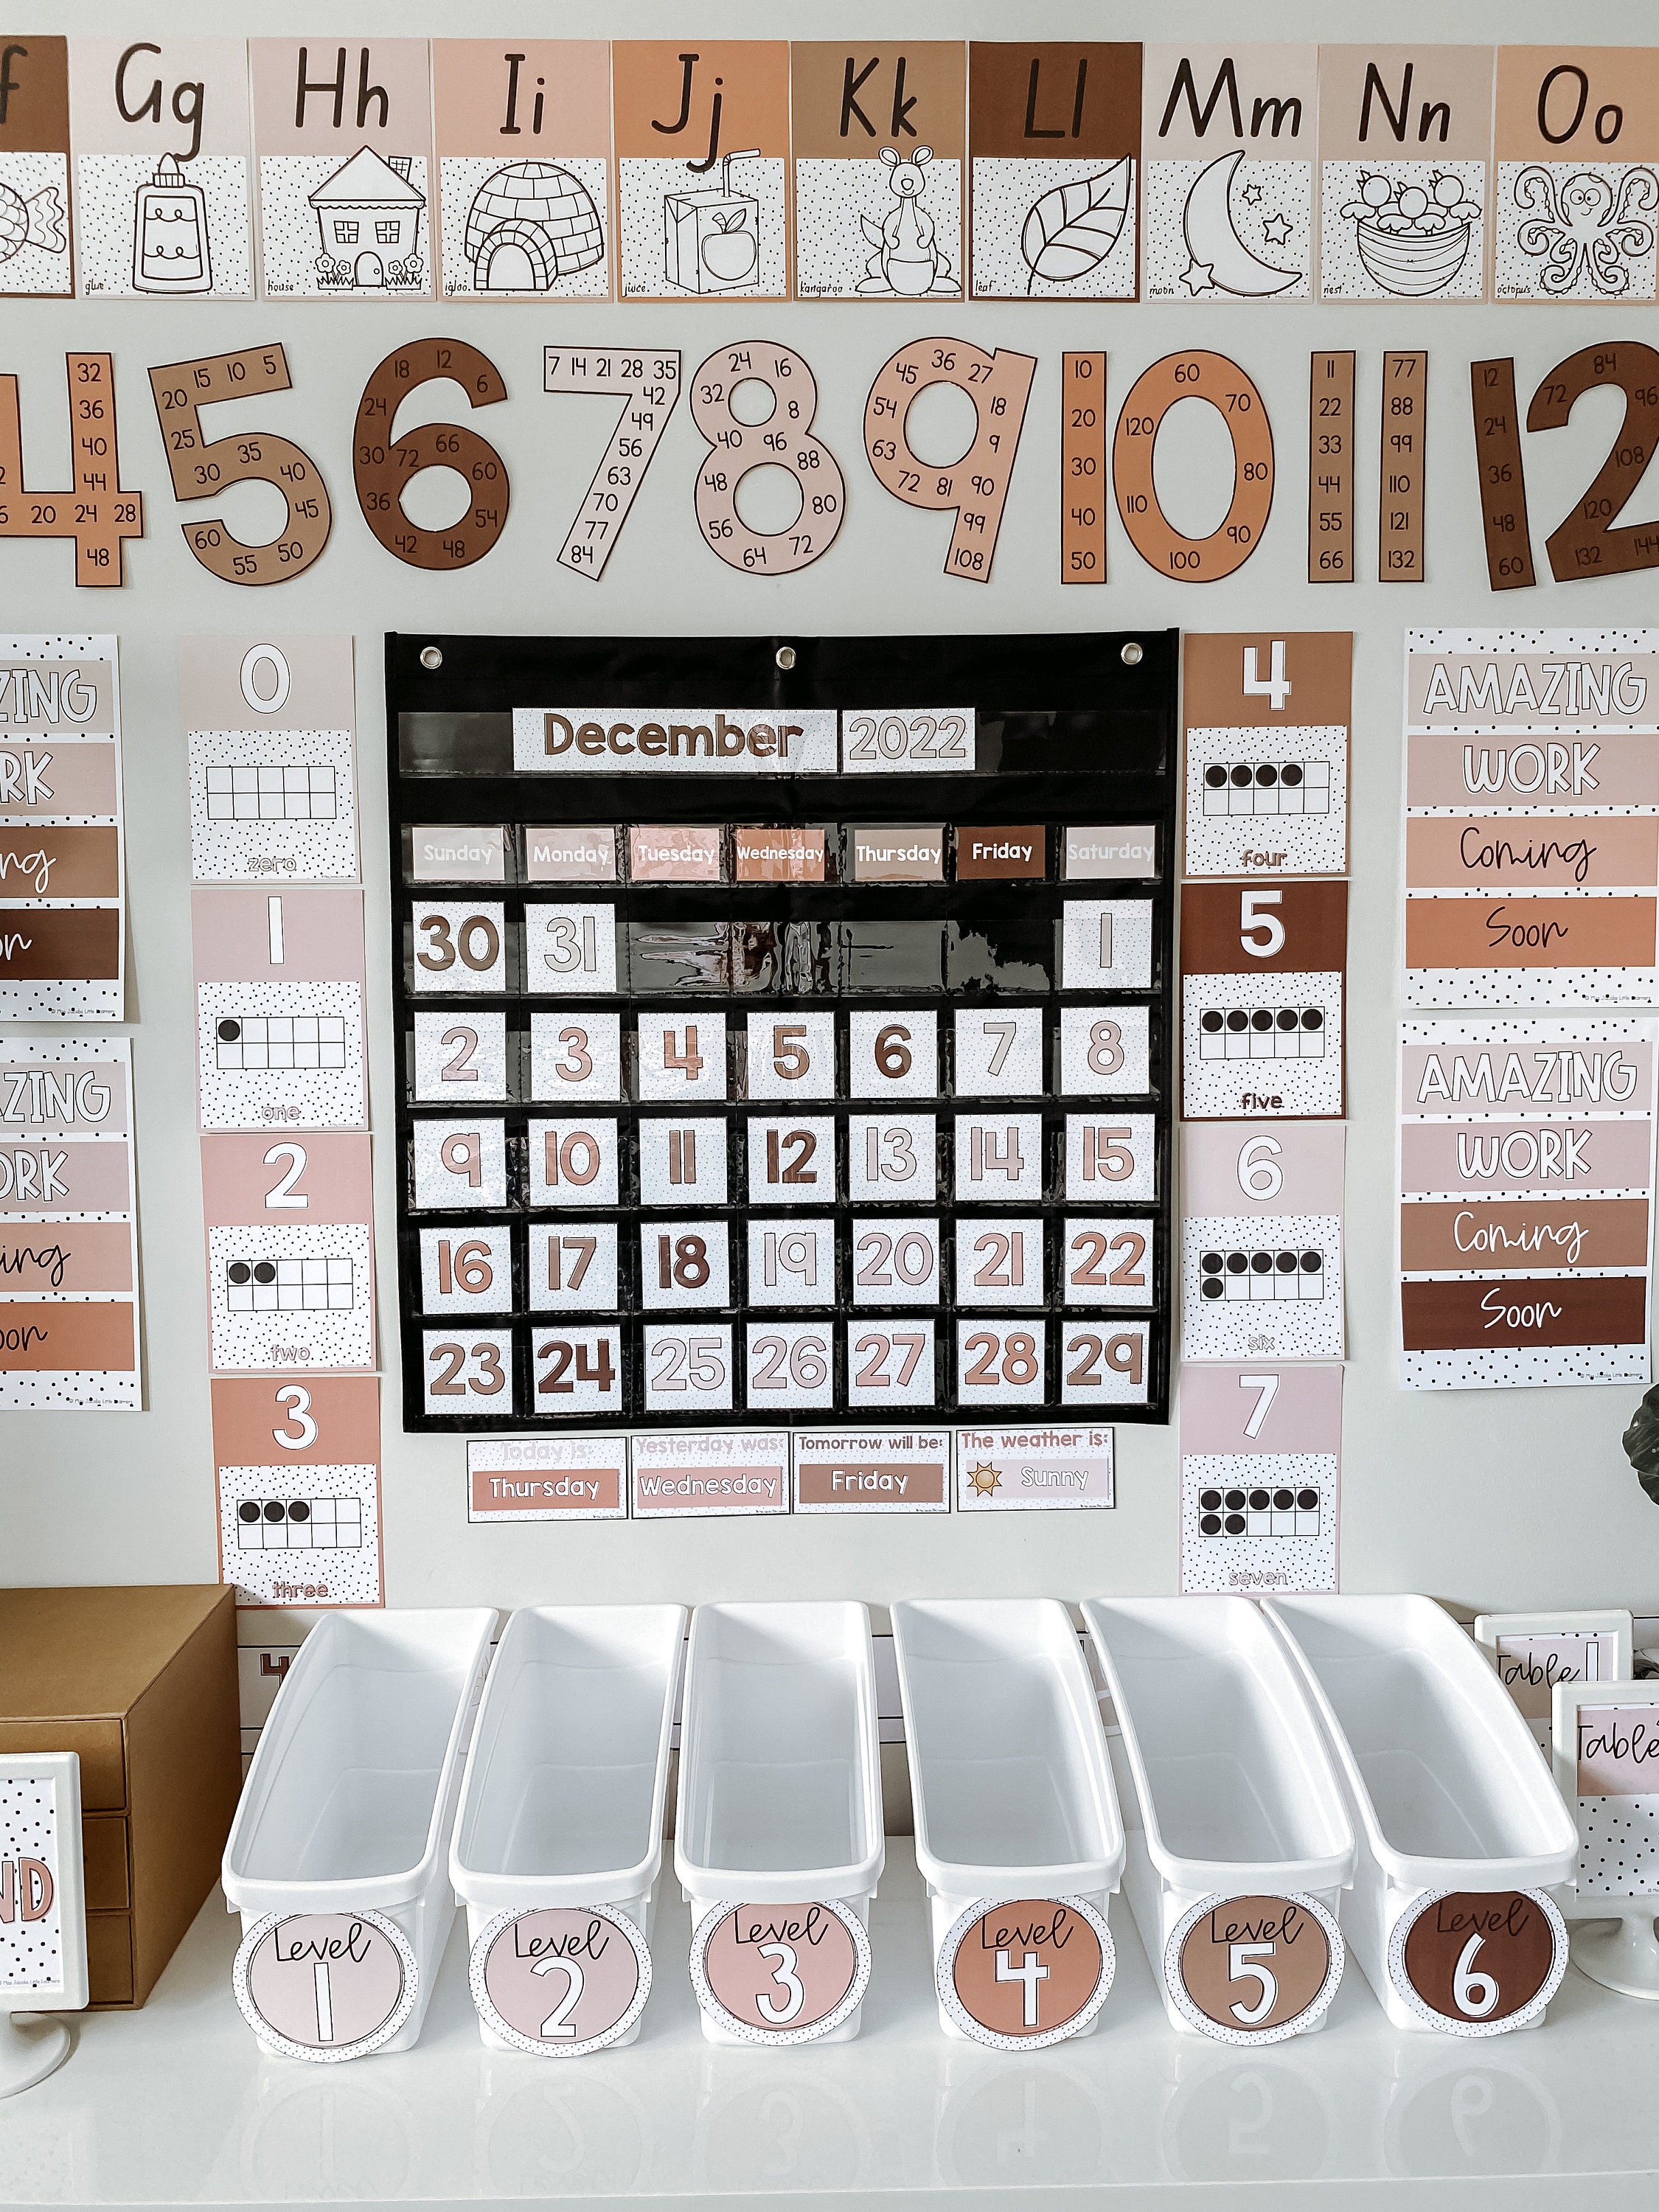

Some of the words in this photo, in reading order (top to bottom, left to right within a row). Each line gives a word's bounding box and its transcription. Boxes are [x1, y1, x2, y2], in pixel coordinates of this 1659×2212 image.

[294, 46, 390, 129] Hh
[499, 52, 546, 136] Ii
[838, 56, 919, 138] Kk
[1023, 58, 1088, 139] Ll
[1158, 57, 1301, 139] Mm
[114, 41, 205, 161] Gg
[650, 53, 724, 173] Jj
[1357, 61, 1453, 142] Nn
[1537, 64, 1624, 145] Oo
[85, 280, 105, 295] glue
[267, 279, 295, 291] house
[799, 282, 844, 297] kangaroo
[975, 280, 995, 293] leaf
[1148, 286, 1175, 294] moon
[1323, 285, 1343, 294] nest
[1497, 285, 1531, 297] octopus
[192, 368, 212, 389] 15
[226, 362, 246, 383] 10
[263, 354, 278, 375] 5
[548, 356, 560, 378] 7
[570, 357, 587, 378] 14
[595, 358, 612, 378] 21
[620, 358, 644, 379] 28
[653, 360, 678, 380] 35
[728, 351, 752, 372] 24
[931, 349, 957, 372] 36
[1326, 359, 1336, 380] 11
[1593, 352, 1618, 375] 84
[1174, 364, 1201, 384] 60
[1483, 368, 1499, 388] 12
[79, 399, 105, 420] 36
[364, 397, 388, 417] 24
[787, 400, 801, 420] 8
[1125, 417, 1155, 437] 120
[81, 437, 108, 457] 40
[353, 337, 511, 571] 6
[434, 434, 461, 454] 66
[762, 432, 788, 453] 96
[1318, 434, 1343, 455] 33
[147, 342, 332, 586] 5
[543, 345, 682, 582] 7
[689, 340, 846, 575] 8
[863, 336, 1037, 583] 9
[1061, 349, 1275, 585] 10
[1071, 456, 1097, 477] 30
[1307, 350, 1428, 584] 11
[1487, 463, 1513, 484] 36
[935, 477, 954, 498] 81
[30, 505, 58, 525] 20
[113, 504, 137, 524] 28
[294, 498, 320, 519] 45
[963, 512, 987, 535] 99
[1389, 512, 1410, 531] 121
[393, 535, 418, 554] 42
[570, 546, 594, 566] 84
[742, 546, 768, 568] 64
[953, 548, 985, 571] 108
[1169, 551, 1201, 571] 100
[1387, 549, 1416, 569] 132
[239, 643, 291, 714] 0
[1242, 639, 1292, 711] 4
[1423, 661, 1648, 716] AMAZING
[544, 713, 805, 758] December
[849, 714, 967, 760] 2022
[1463, 742, 1601, 796] WORK
[247, 857, 298, 873] zero
[423, 844, 493, 865] Sunday
[533, 844, 610, 864] Monday
[638, 844, 714, 865] Tuesday
[737, 846, 825, 863] Wednesday
[855, 844, 942, 865] Thursday
[971, 842, 1033, 861] Friday
[1068, 842, 1155, 862] Saturday
[1241, 849, 1288, 867] four
[1460, 827, 1597, 883] Coming
[1239, 889, 1286, 959] 5
[1485, 905, 1569, 949] Soon
[417, 914, 500, 972] 30
[543, 916, 597, 973] 31
[441, 1026, 479, 1082] 2
[554, 1026, 593, 1082] 3
[663, 1025, 703, 1080] 4
[773, 1025, 810, 1080] 5
[874, 1023, 912, 1079] 6
[983, 1021, 1017, 1077] 7
[1087, 1020, 1124, 1075] 8
[1416, 1050, 1638, 1104] AMAZING
[261, 1105, 302, 1121] one
[1240, 1092, 1283, 1110] five
[1456, 1129, 1593, 1180] WORK
[262, 1141, 310, 1209] 2
[1237, 1134, 1284, 1202] 6
[1453, 1211, 1590, 1265] Coming
[1480, 1287, 1562, 1329] Soon
[270, 1343, 311, 1362] two
[1248, 1334, 1276, 1352] six
[429, 1342, 506, 1396] 23
[537, 1338, 616, 1393] 24
[651, 1337, 726, 1391] 25
[752, 1335, 827, 1389] 26
[855, 1333, 926, 1387] 27
[964, 1332, 1039, 1385] 28
[1067, 1332, 1144, 1385] 29
[271, 1383, 319, 1451] 3
[1239, 1373, 1280, 1440] 7
[635, 1436, 734, 1455] Yesterday
[799, 1436, 883, 1450] Tomorrow
[888, 1435, 914, 1450] will
[917, 1435, 944, 1450] be:
[961, 1432, 994, 1449] The
[1000, 1430, 1082, 1449] weather
[1088, 1430, 1109, 1447] is:
[500, 1442, 564, 1463] Today
[489, 1475, 601, 1500] Thursday
[639, 1473, 778, 1498] Wednesday
[831, 1470, 909, 1495] Friday
[1020, 1466, 1089, 1491] Sunny
[271, 1581, 329, 1599] three
[1228, 1571, 1288, 1586] seven
[1497, 1652, 1581, 1689] Table
[733, 1906, 830, 1947] Level
[980, 1907, 1074, 1950] Level
[1209, 1905, 1307, 1947] Level
[1436, 1897, 1530, 1937] Level
[274, 1921, 372, 1964] Level
[513, 1919, 611, 1961] Level
[755, 1943, 806, 2025] 3
[1228, 1941, 1279, 2025] 5
[1452, 1931, 1500, 2018] 6
[529, 1955, 586, 2038] 2
[994, 1949, 1050, 2028] 4
[314, 1962, 335, 2042] 1
